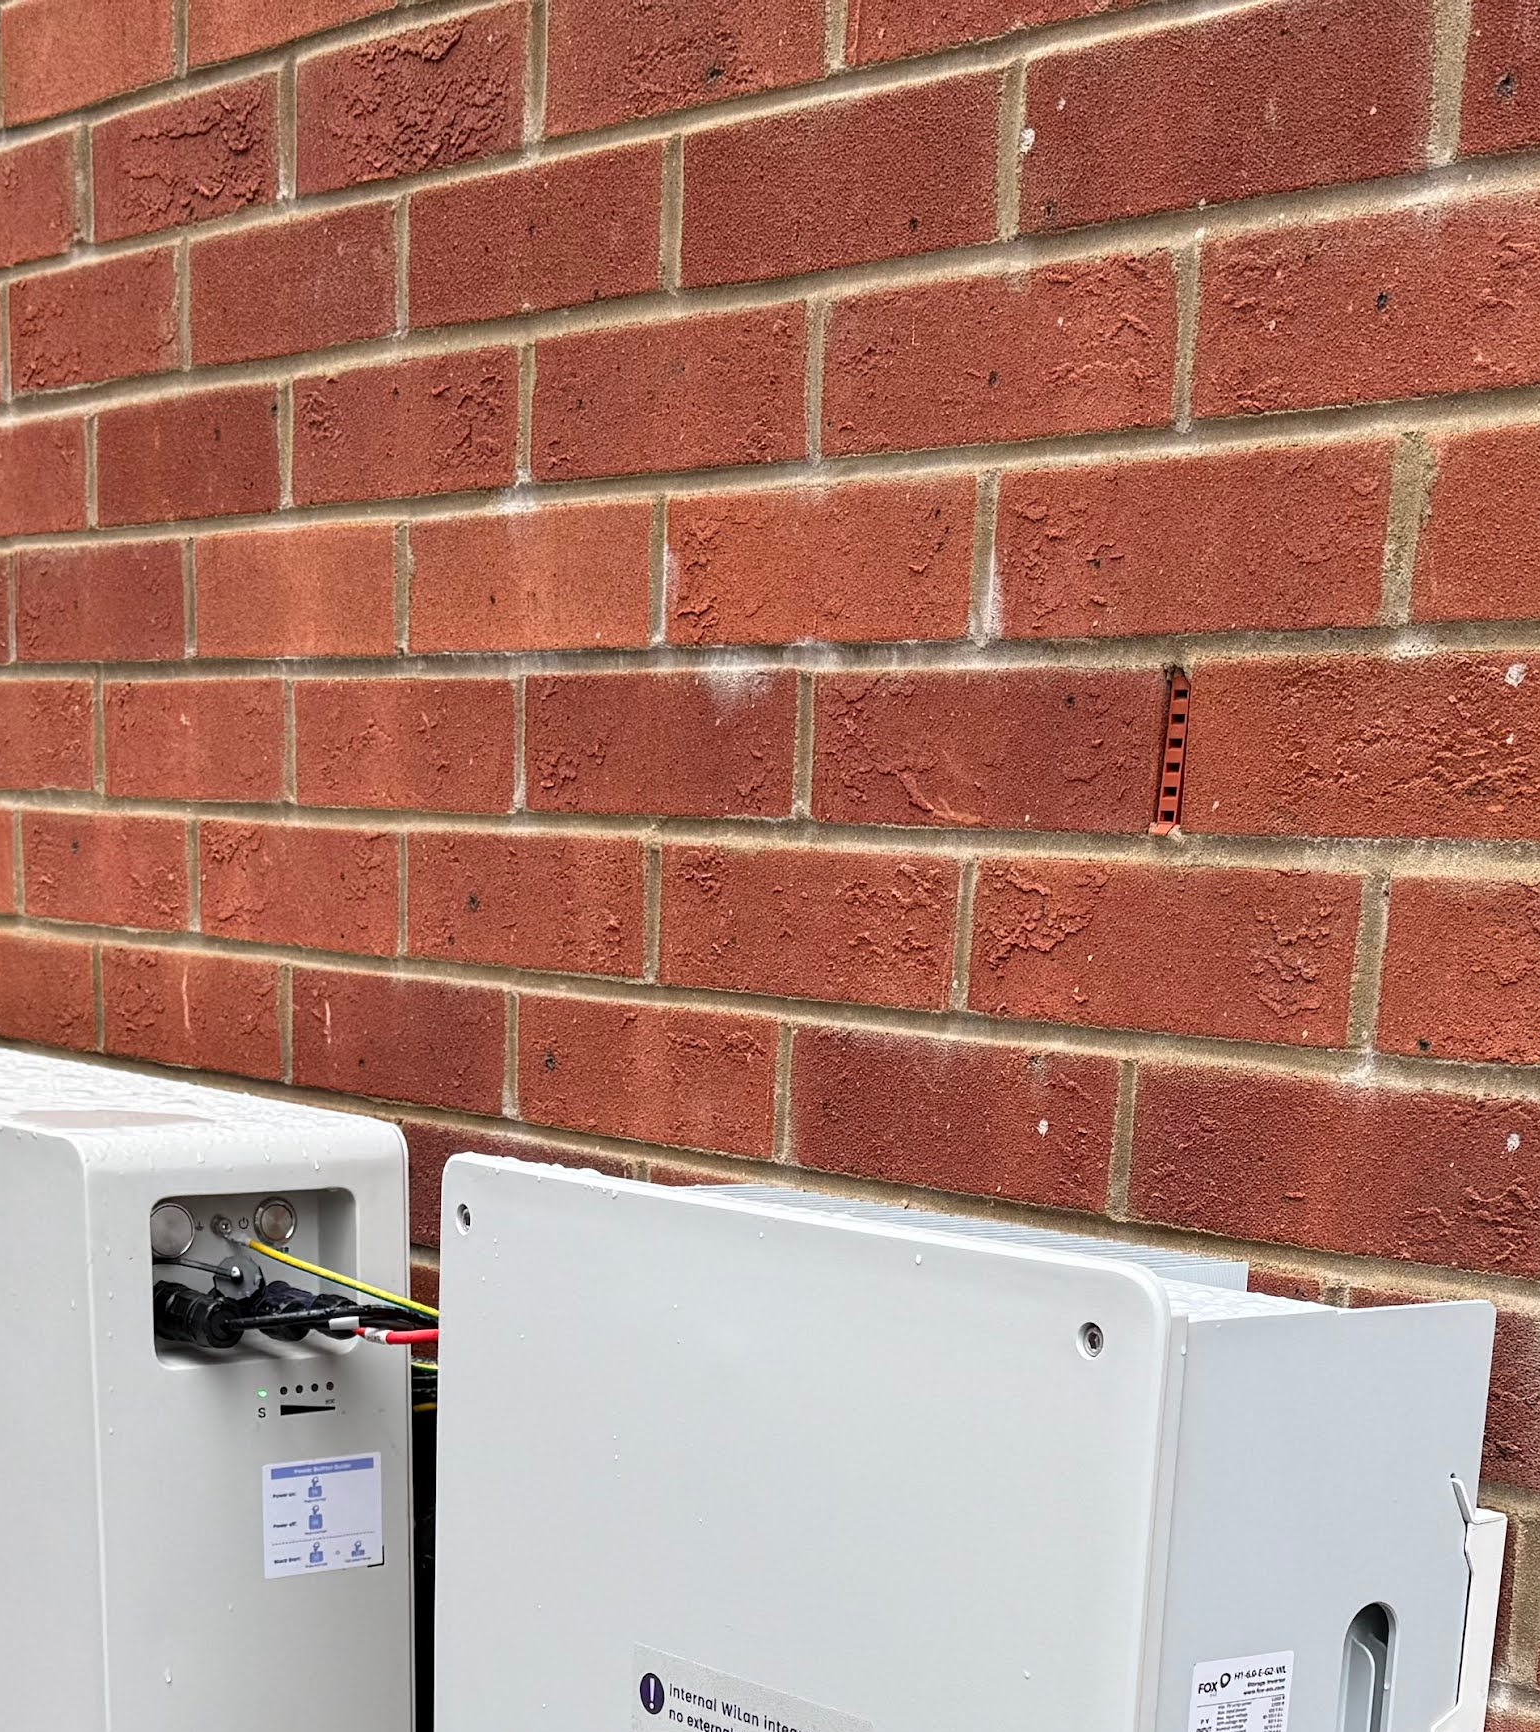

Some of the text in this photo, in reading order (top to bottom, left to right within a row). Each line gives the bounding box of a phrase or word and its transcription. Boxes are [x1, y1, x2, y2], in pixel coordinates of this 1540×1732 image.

[257, 1407, 266, 1419] S
[1198, 1681, 1218, 1694] FOX
[668, 1683, 717, 1712] Internal
[668, 1708, 683, 1723] no
